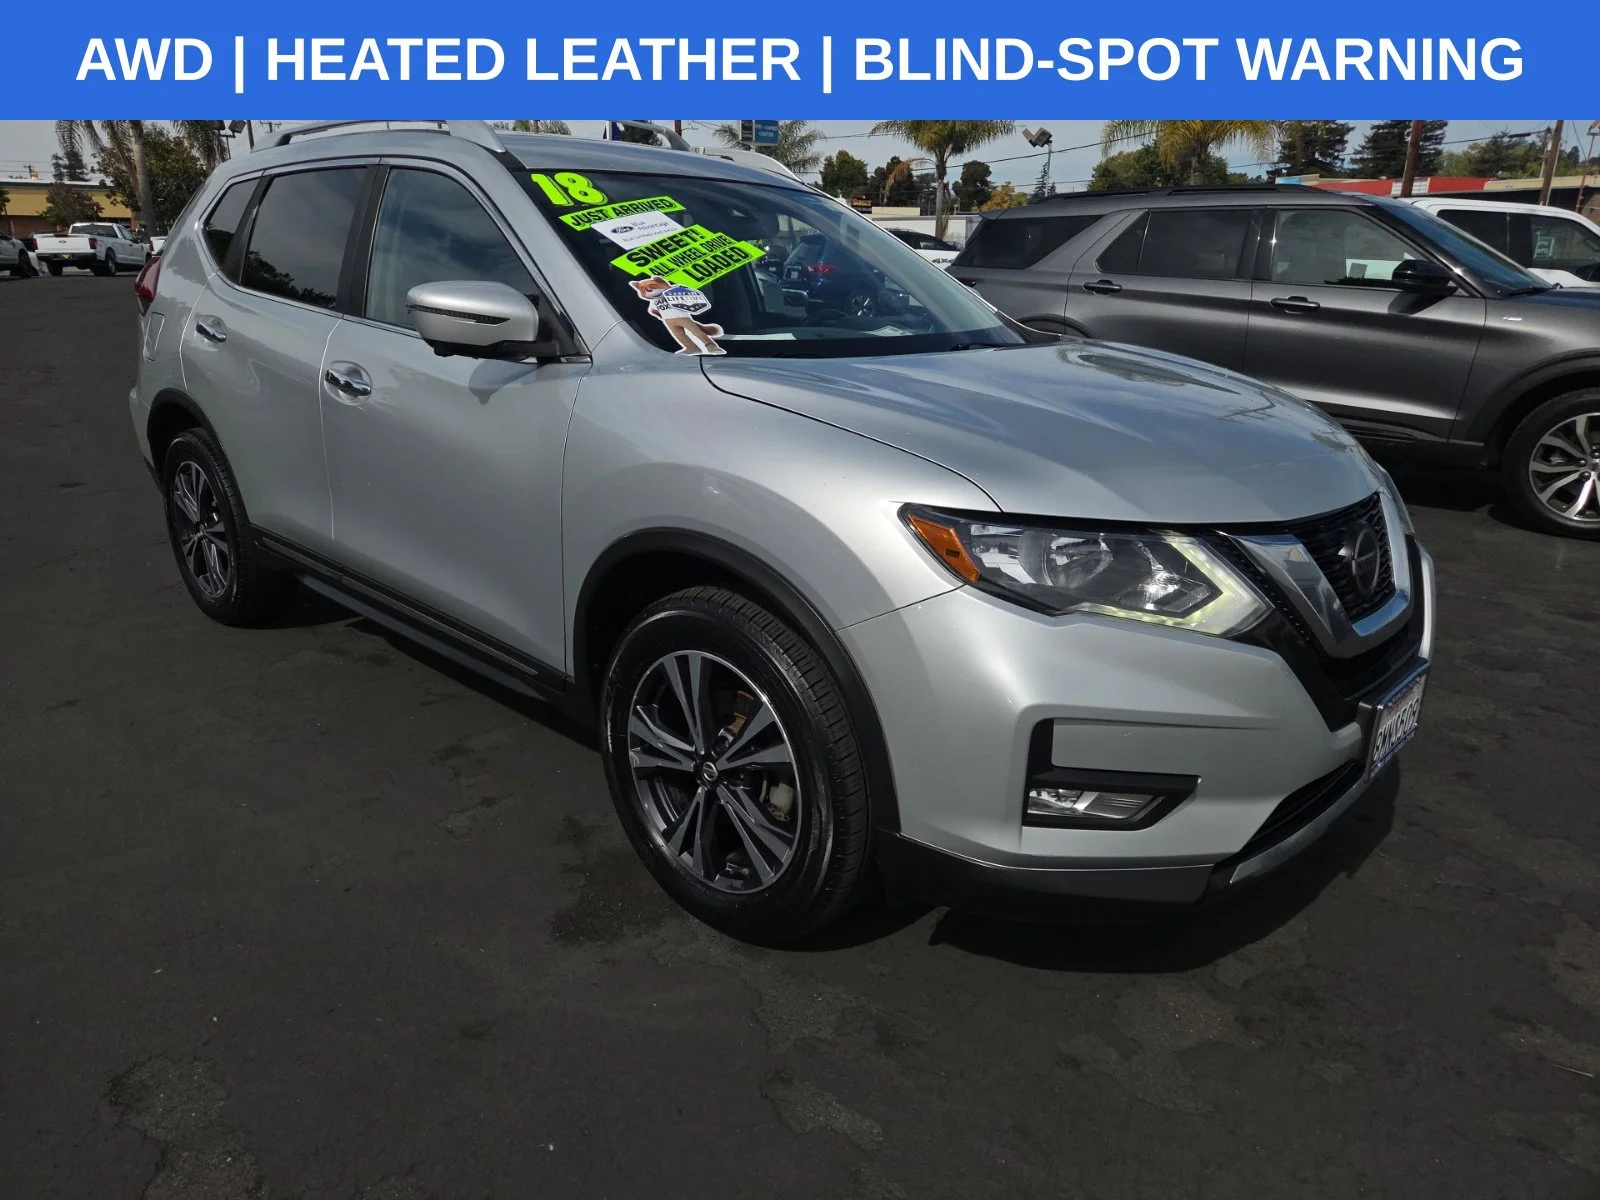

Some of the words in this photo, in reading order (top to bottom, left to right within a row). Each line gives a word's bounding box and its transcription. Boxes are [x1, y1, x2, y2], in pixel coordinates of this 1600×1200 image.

[531, 172, 608, 207] 18
[570, 208, 611, 227] JUST
[614, 198, 676, 217] ARRIVED
[626, 228, 706, 268] SWEET!
[648, 262, 676, 277] ALL
[667, 247, 706, 268] WHEEL
[700, 235, 736, 253] DRIVE
[682, 245, 752, 283] LOADED
